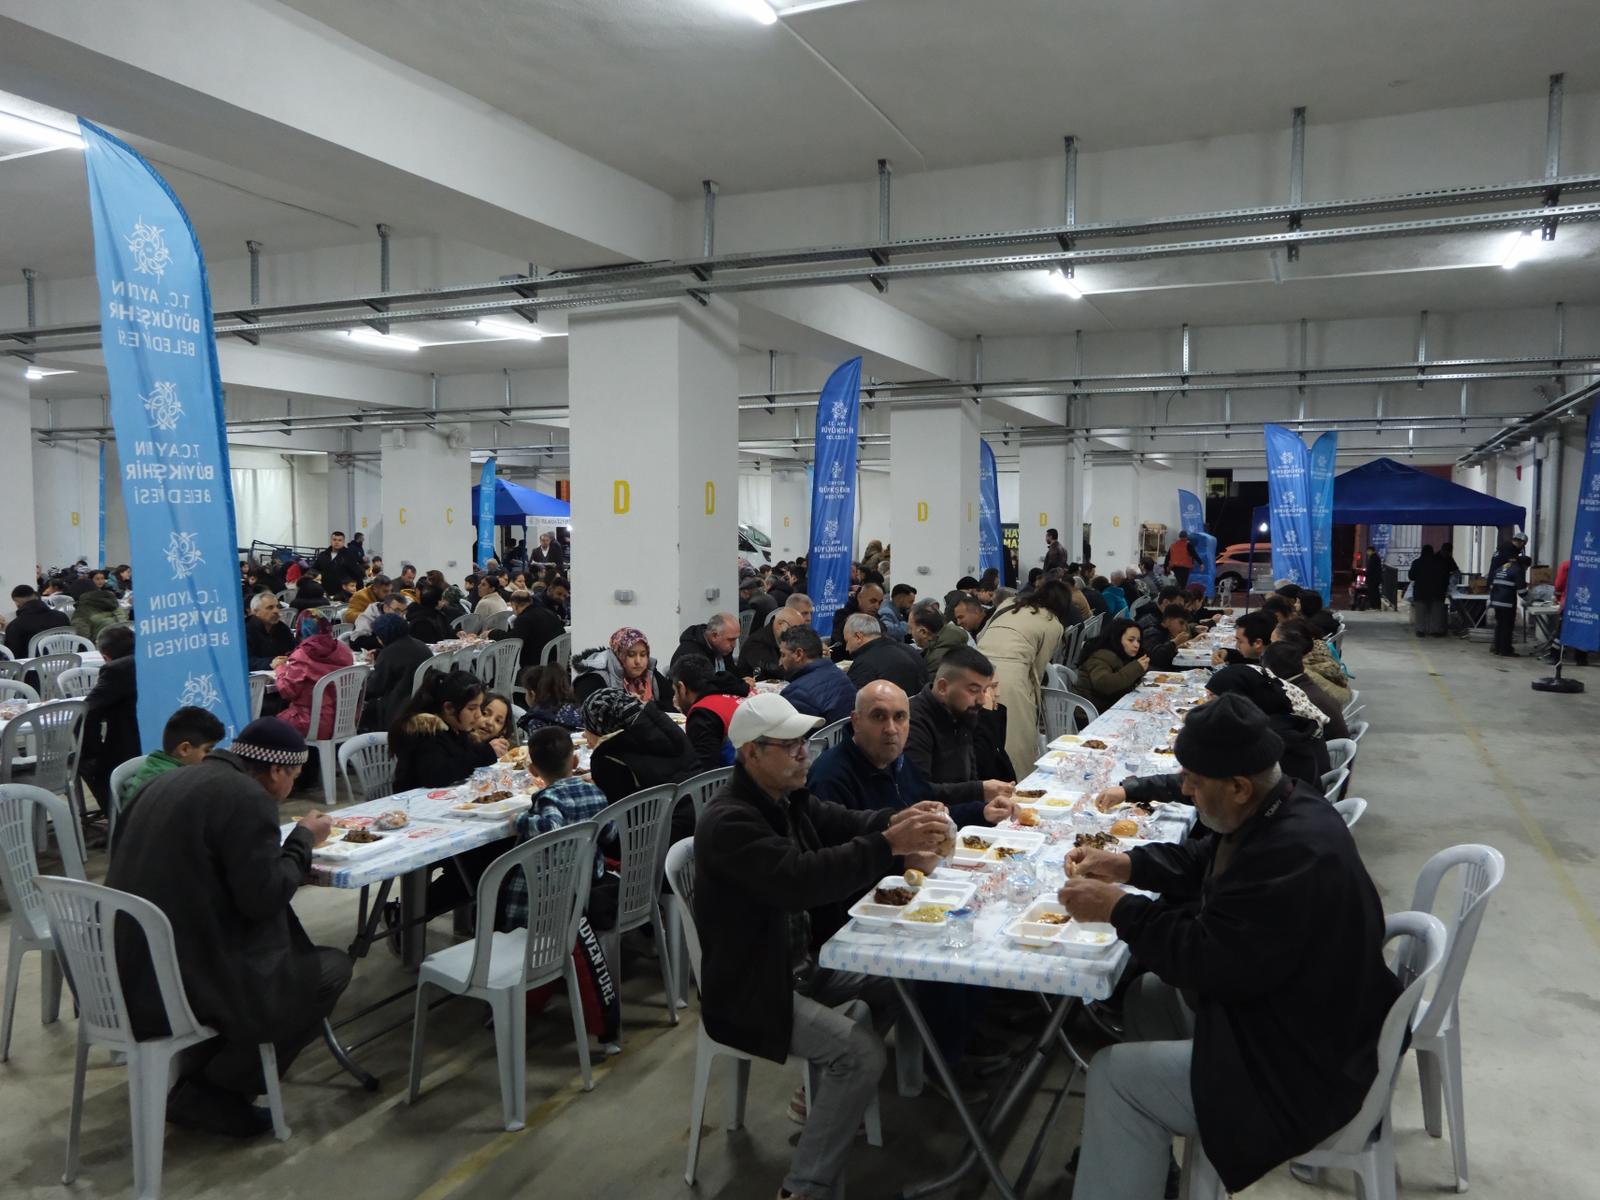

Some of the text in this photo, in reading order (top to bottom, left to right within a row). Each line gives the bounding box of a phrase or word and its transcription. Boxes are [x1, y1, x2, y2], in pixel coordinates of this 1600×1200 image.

[613, 479, 630, 514] D
[705, 481, 715, 516] D
[917, 502, 928, 522] D
[1039, 512, 1047, 527] D
[579, 915, 616, 1006] ADVENTURE
